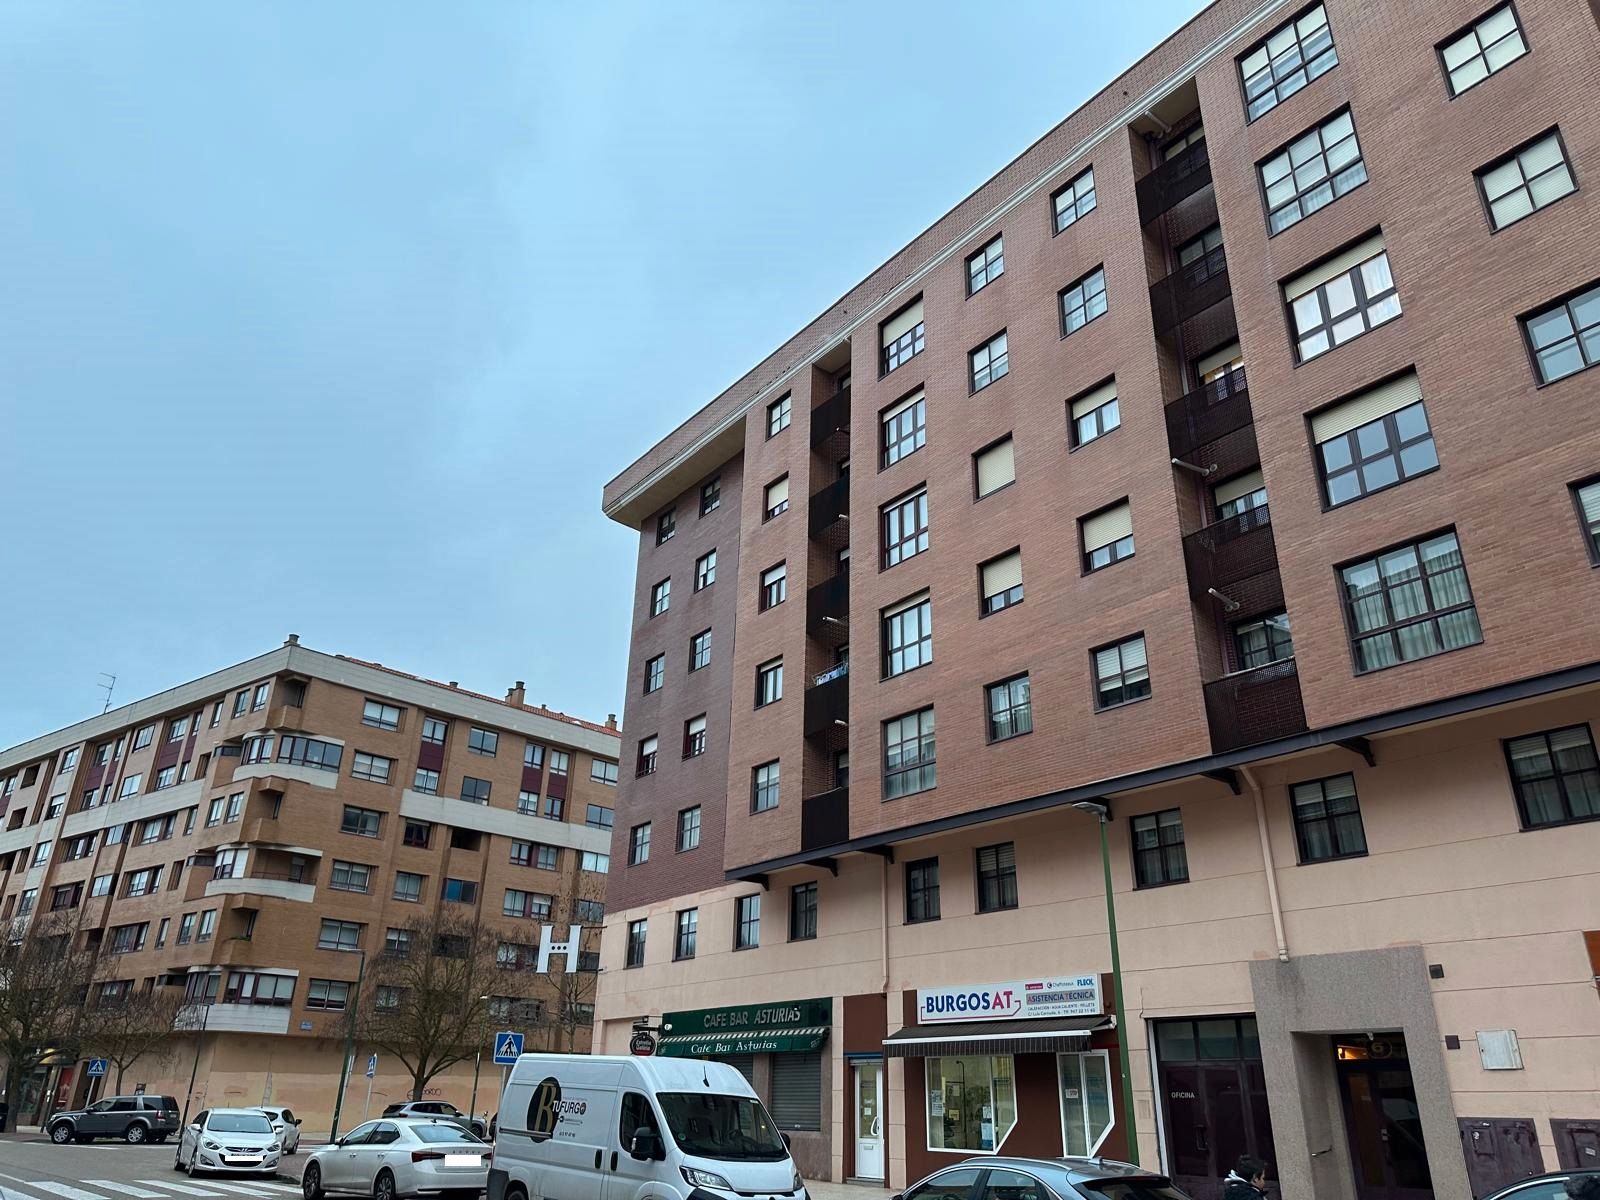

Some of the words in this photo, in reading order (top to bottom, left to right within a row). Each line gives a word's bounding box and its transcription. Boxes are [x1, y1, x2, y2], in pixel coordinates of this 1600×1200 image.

[536, 925, 581, 973] H
[926, 991, 1013, 1013] BURGOSAT
[1028, 993, 1064, 1002] ASISTENCIA
[730, 1011, 748, 1026] BAR
[754, 1006, 801, 1024] ASTURIAS
[715, 1042, 731, 1052] Bar
[736, 1040, 777, 1052] Asturias
[1171, 1091, 1195, 1099] OFICINA
